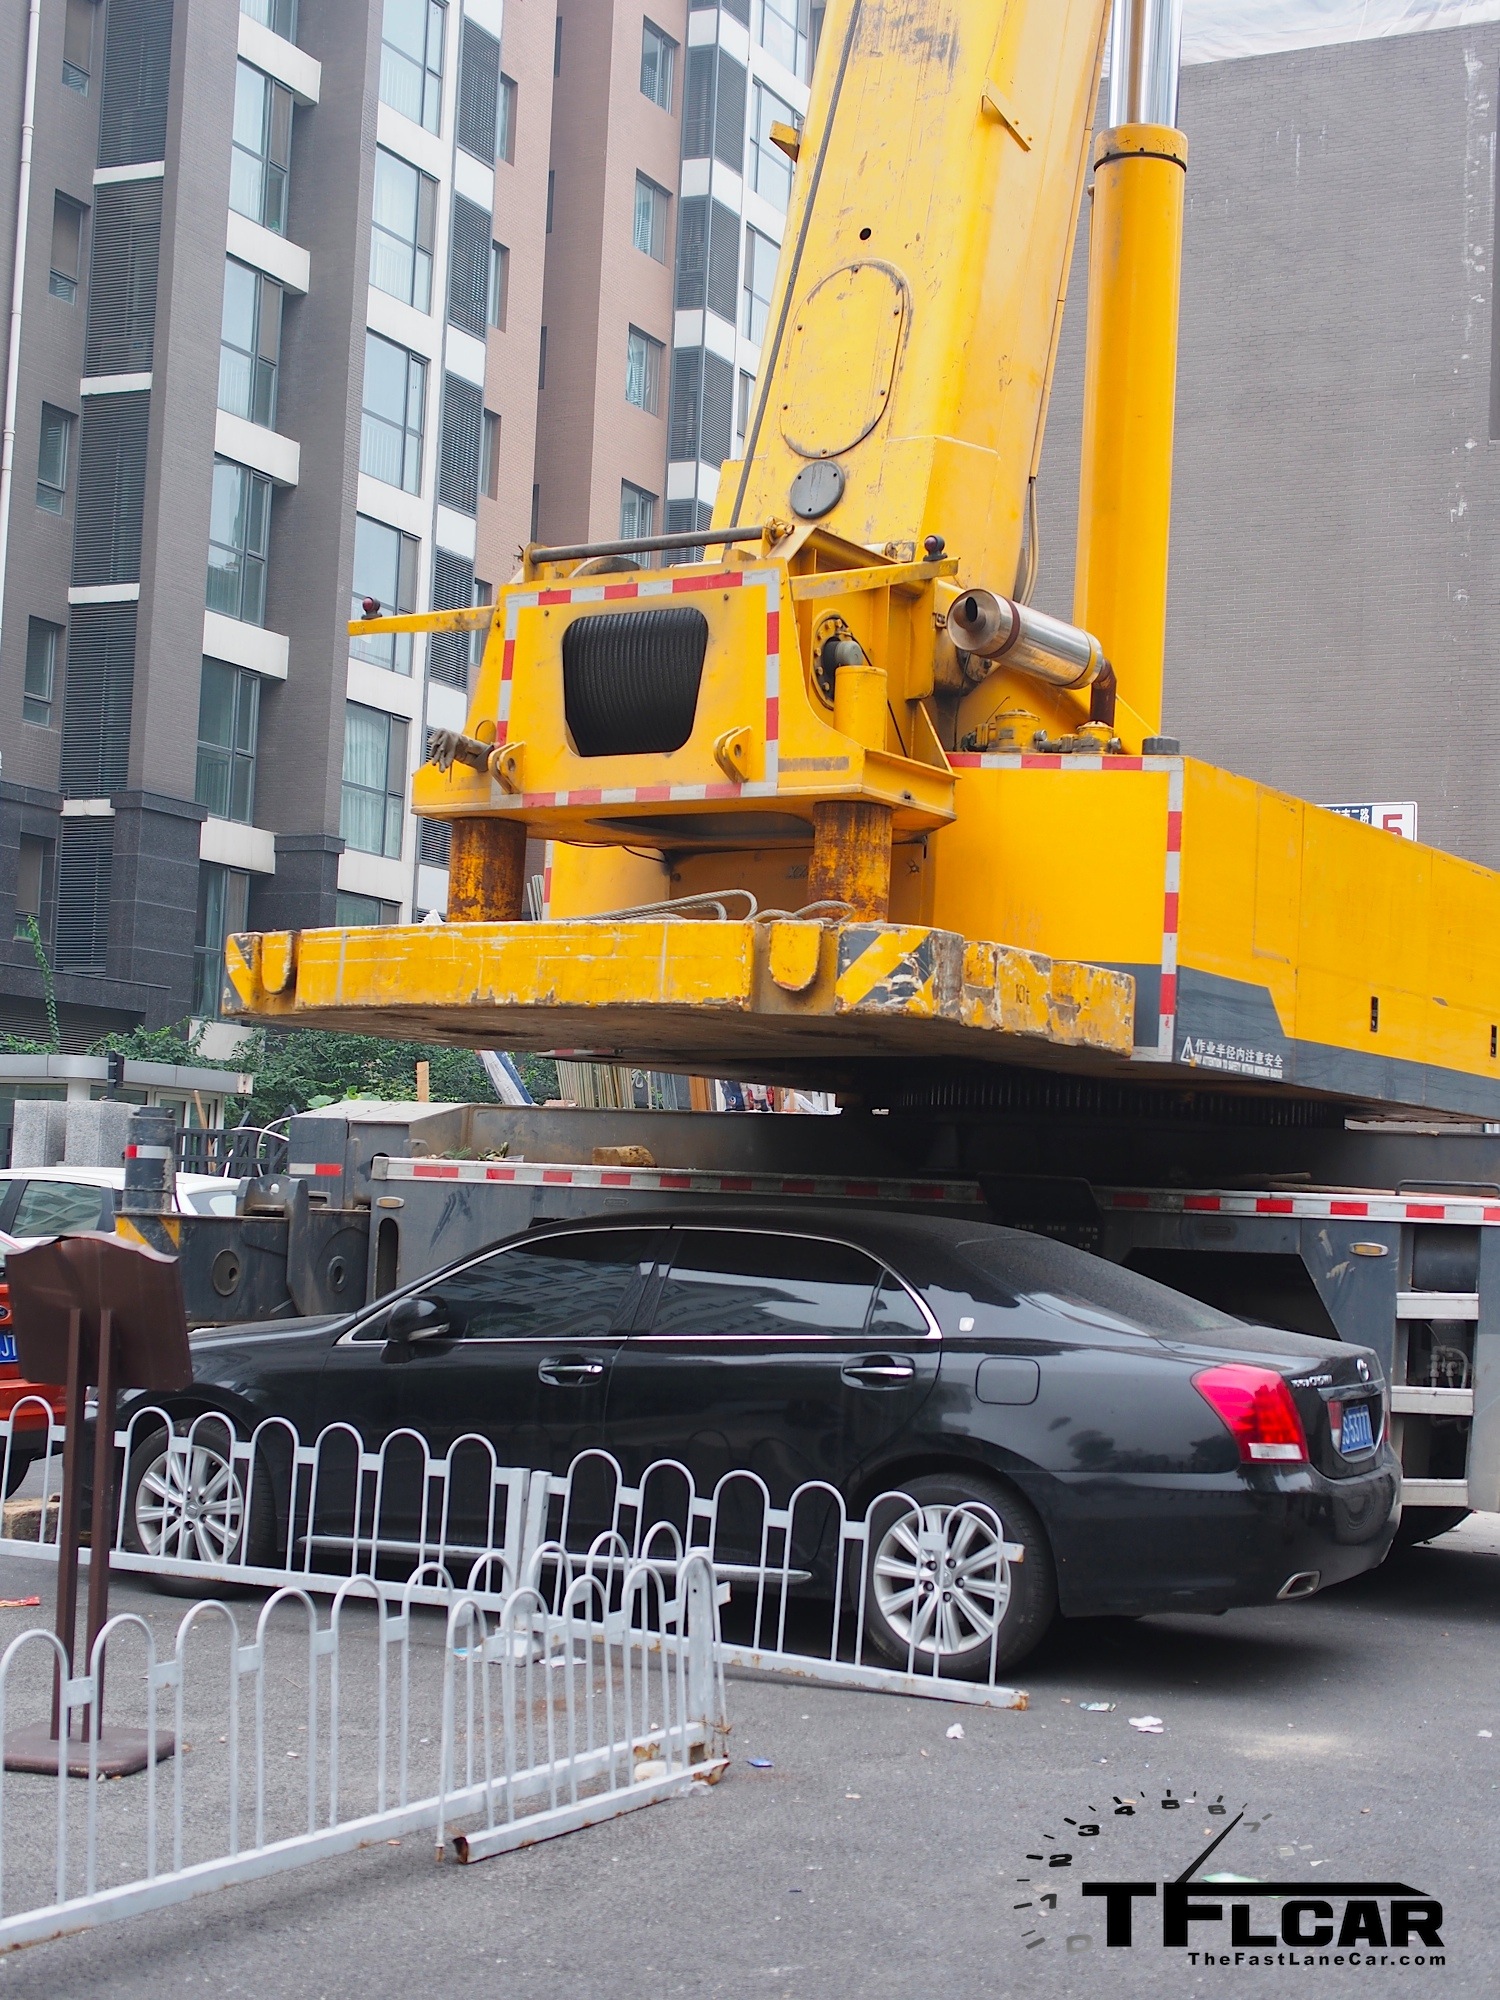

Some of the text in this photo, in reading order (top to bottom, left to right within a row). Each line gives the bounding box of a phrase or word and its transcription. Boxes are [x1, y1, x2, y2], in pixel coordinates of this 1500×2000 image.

[1194, 1038, 1284, 1068] 作业半径内注意安全
